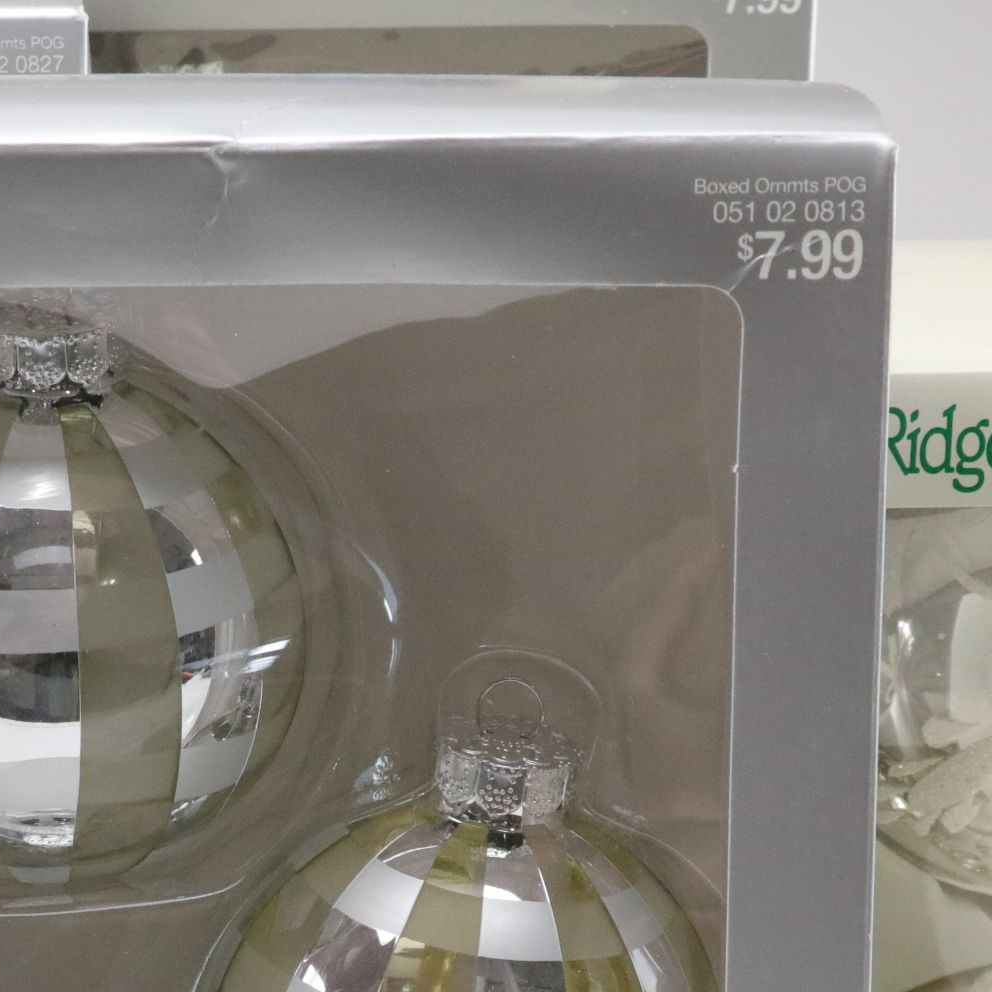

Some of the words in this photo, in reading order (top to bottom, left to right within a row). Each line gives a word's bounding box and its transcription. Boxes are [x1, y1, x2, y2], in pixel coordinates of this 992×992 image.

[31, 36, 65, 49] POG
[15, 55, 64, 73] 0827
[694, 178, 750, 194] Boxed
[755, 177, 819, 194] Ornmts
[825, 176, 867, 193] POG
[713, 201, 755, 223] 051
[766, 201, 796, 223] 02
[804, 200, 865, 222] 0813
[737, 229, 864, 280] $7.99
[888, 403, 992, 493] Ridg
